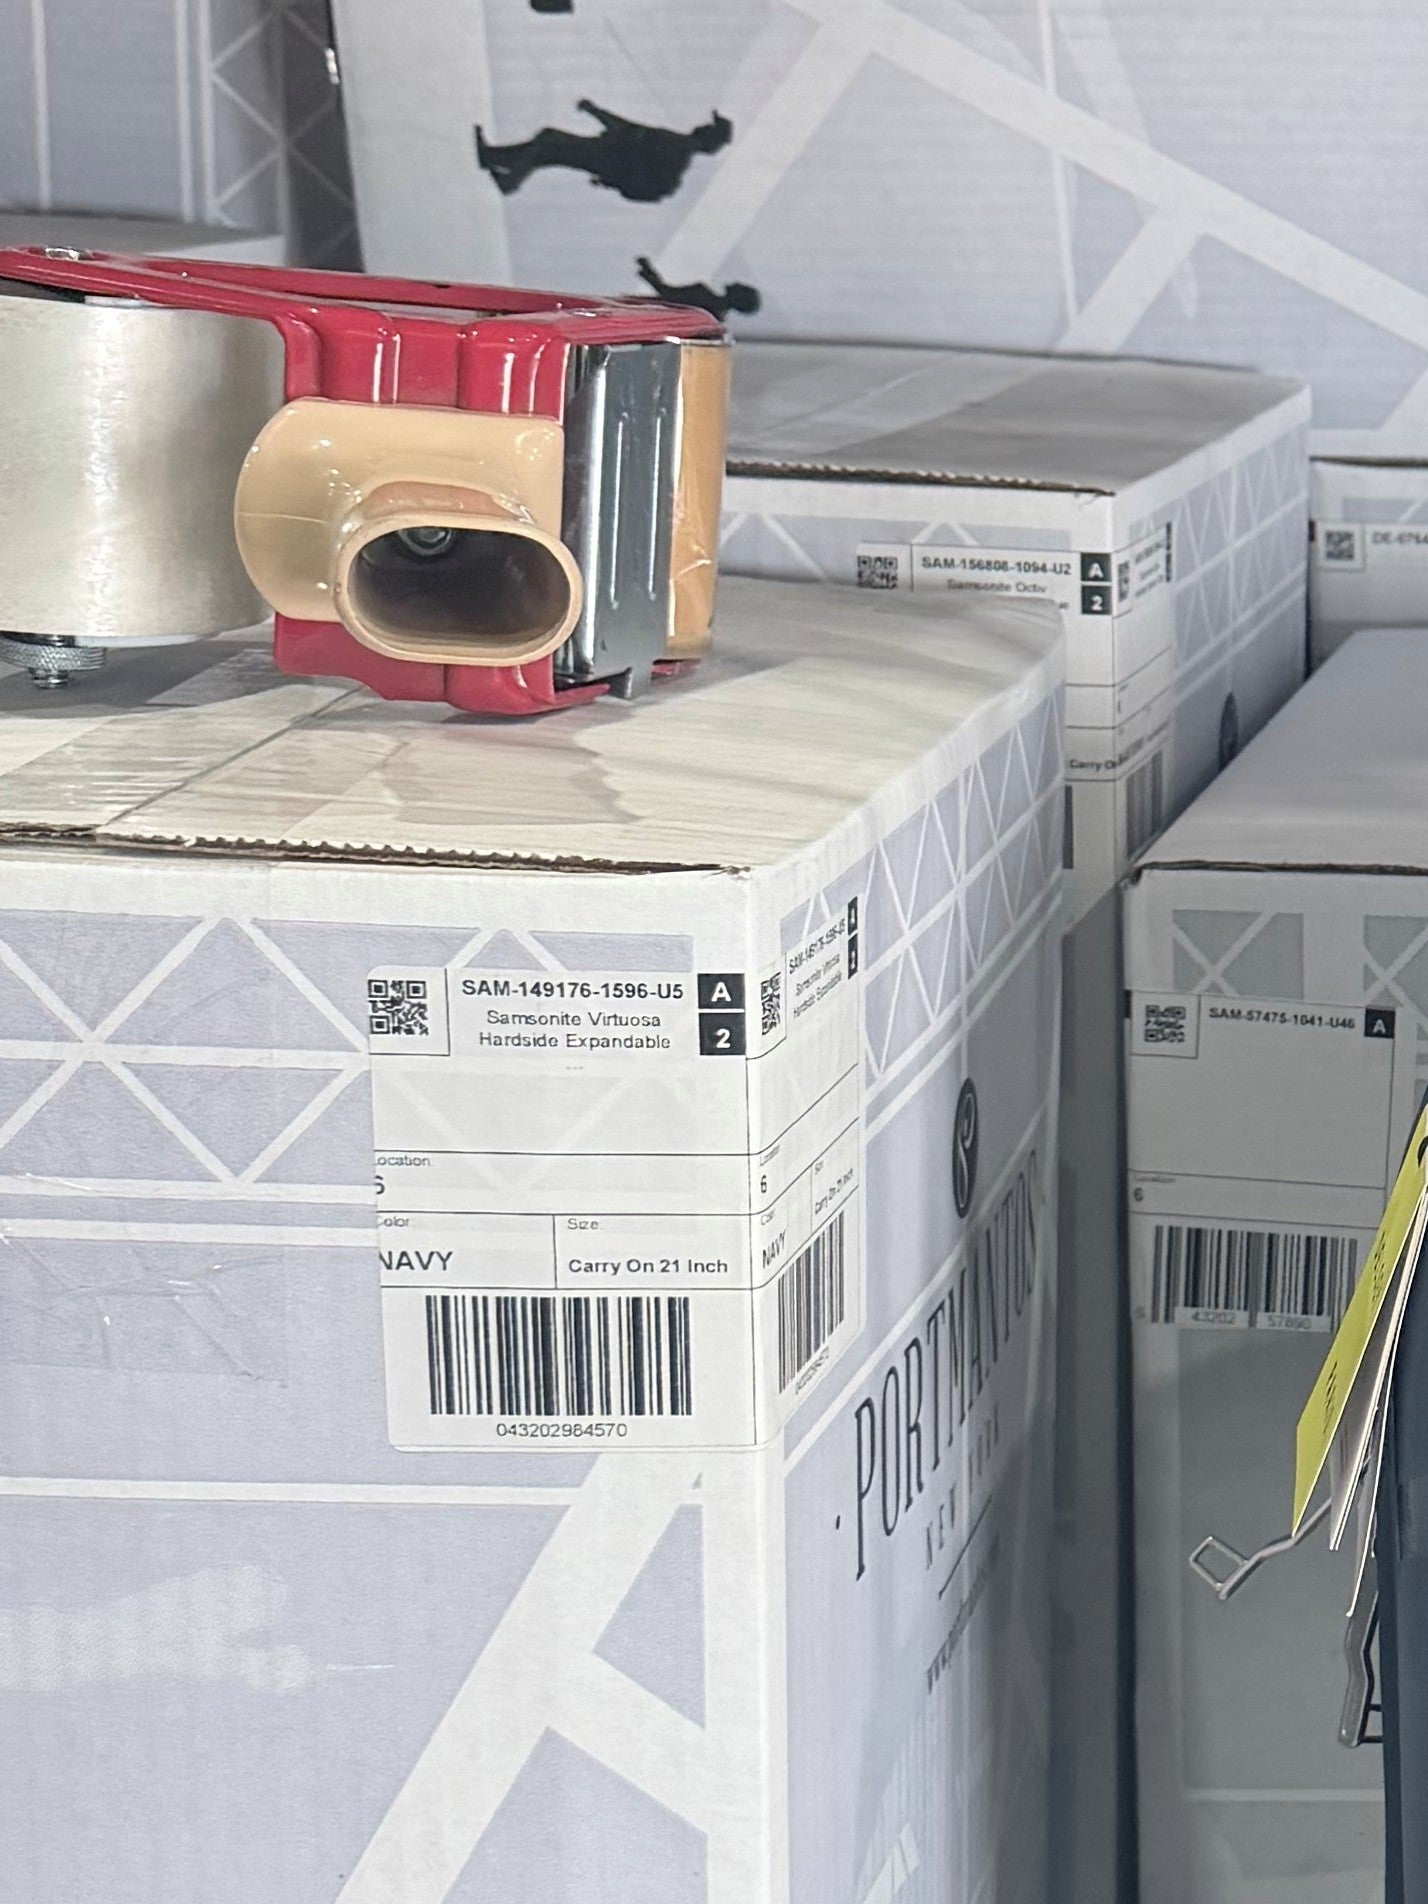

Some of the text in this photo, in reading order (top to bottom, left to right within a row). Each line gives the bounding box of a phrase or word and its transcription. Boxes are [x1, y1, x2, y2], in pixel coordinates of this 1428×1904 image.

[1088, 562, 1104, 578] A
[1090, 595, 1102, 611] 2
[461, 978, 684, 1000] SAM-149176-1596-U5
[711, 983, 731, 1003] A
[486, 1010, 662, 1028] Samsonite Virtuosa
[1373, 1018, 1386, 1035] A
[479, 1032, 671, 1053] Hardside Expandable
[716, 1030, 731, 1048] 2
[376, 1155, 431, 1167] ocation
[760, 1175, 767, 1193] 6
[379, 1216, 410, 1228] olor
[380, 1251, 453, 1271] NAVY
[568, 1258, 728, 1276] Carry On 21 Inch
[496, 1422, 628, 1439] 043202984570
